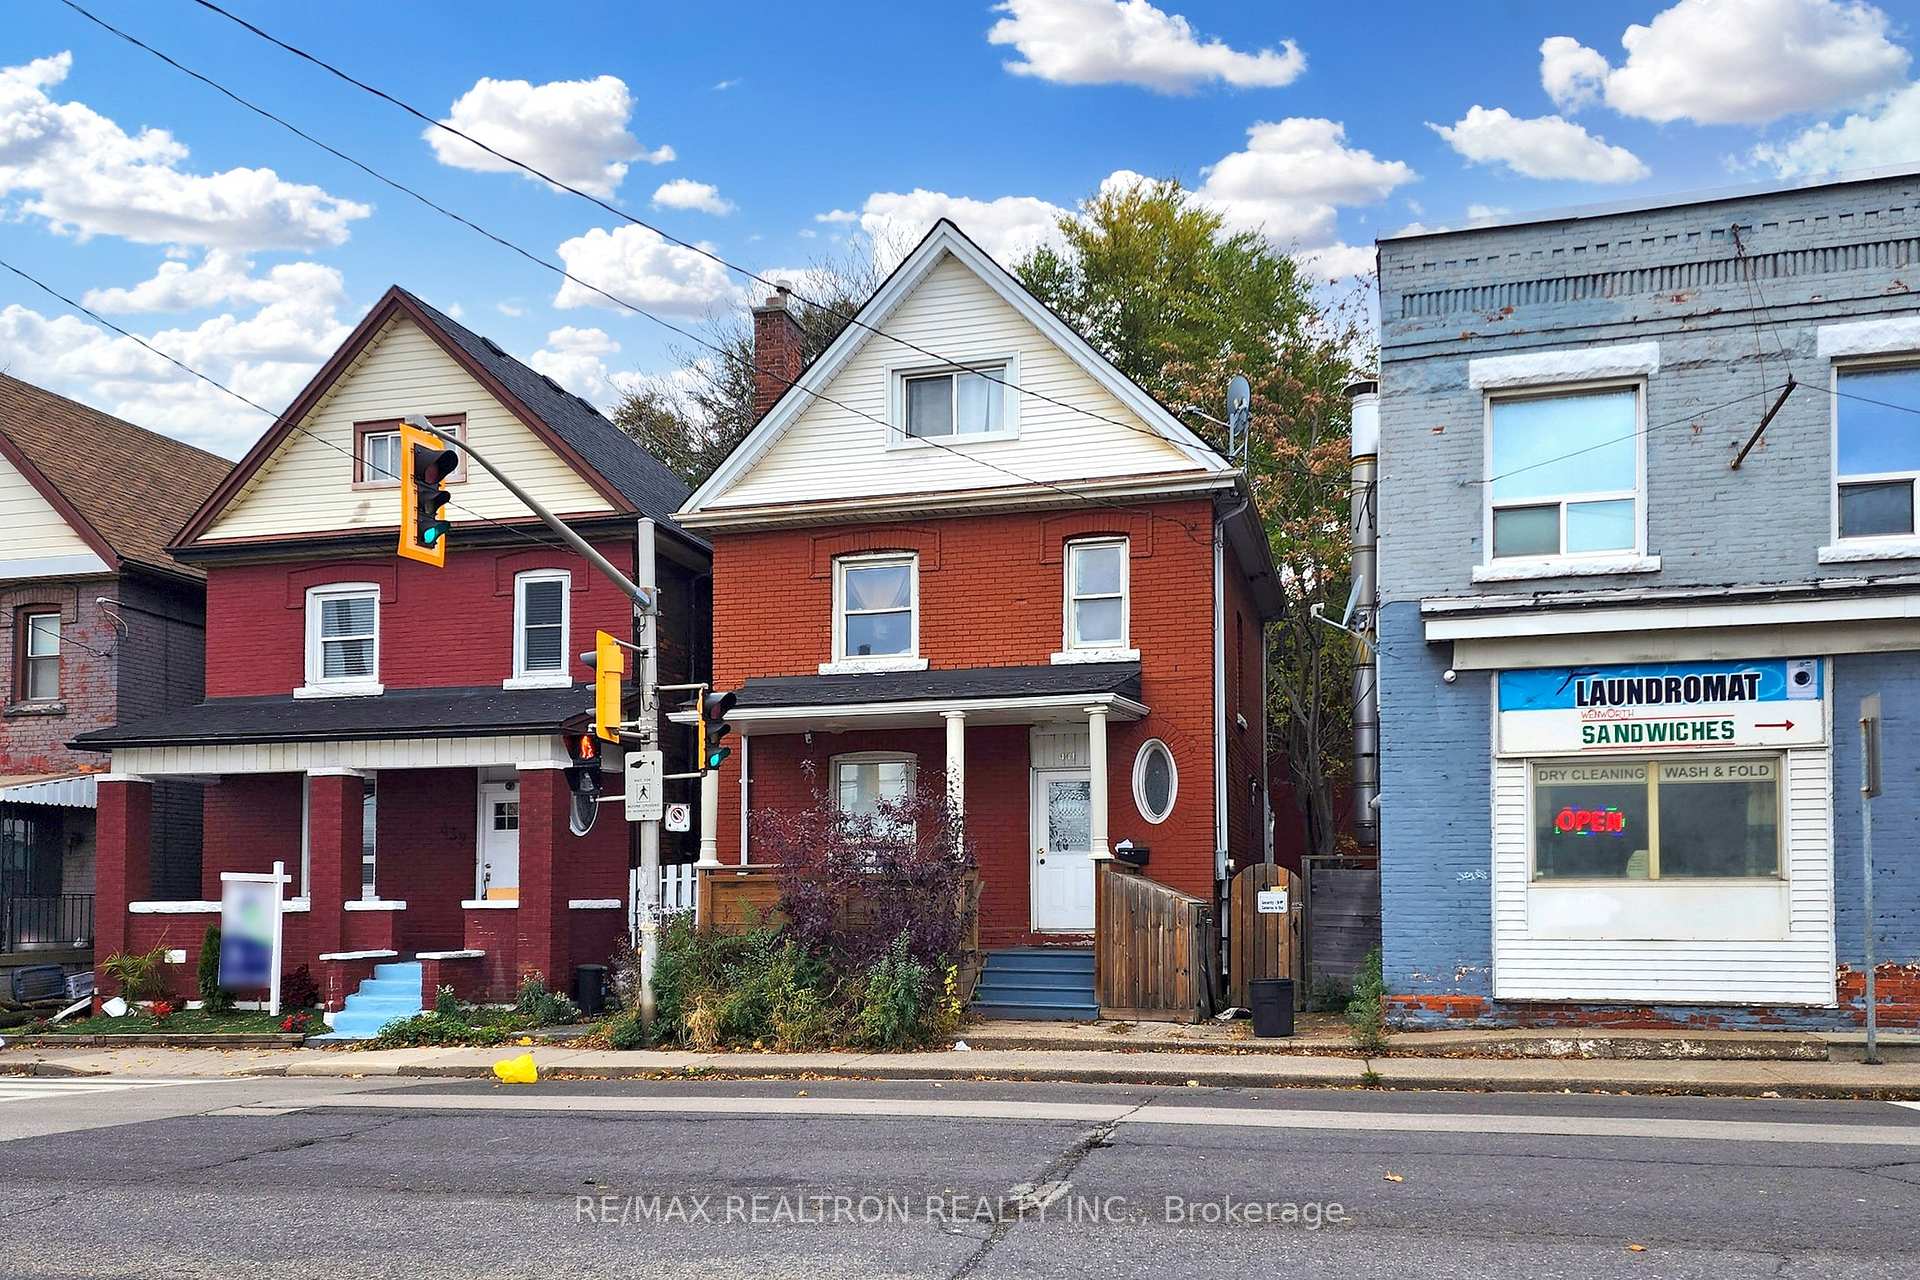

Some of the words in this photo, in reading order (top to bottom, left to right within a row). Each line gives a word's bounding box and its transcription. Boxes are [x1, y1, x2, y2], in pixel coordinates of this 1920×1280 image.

[1576, 673, 1761, 707] LAUNDROMAT
[1582, 720, 1735, 744] SANDWICHES
[1539, 769, 1569, 781] DRY
[1571, 767, 1645, 780] CLEANING
[1665, 766, 1709, 778] WASH
[1714, 766, 1724, 777] &
[1729, 765, 1769, 777] FOLD
[1556, 808, 1623, 832] OPEN
